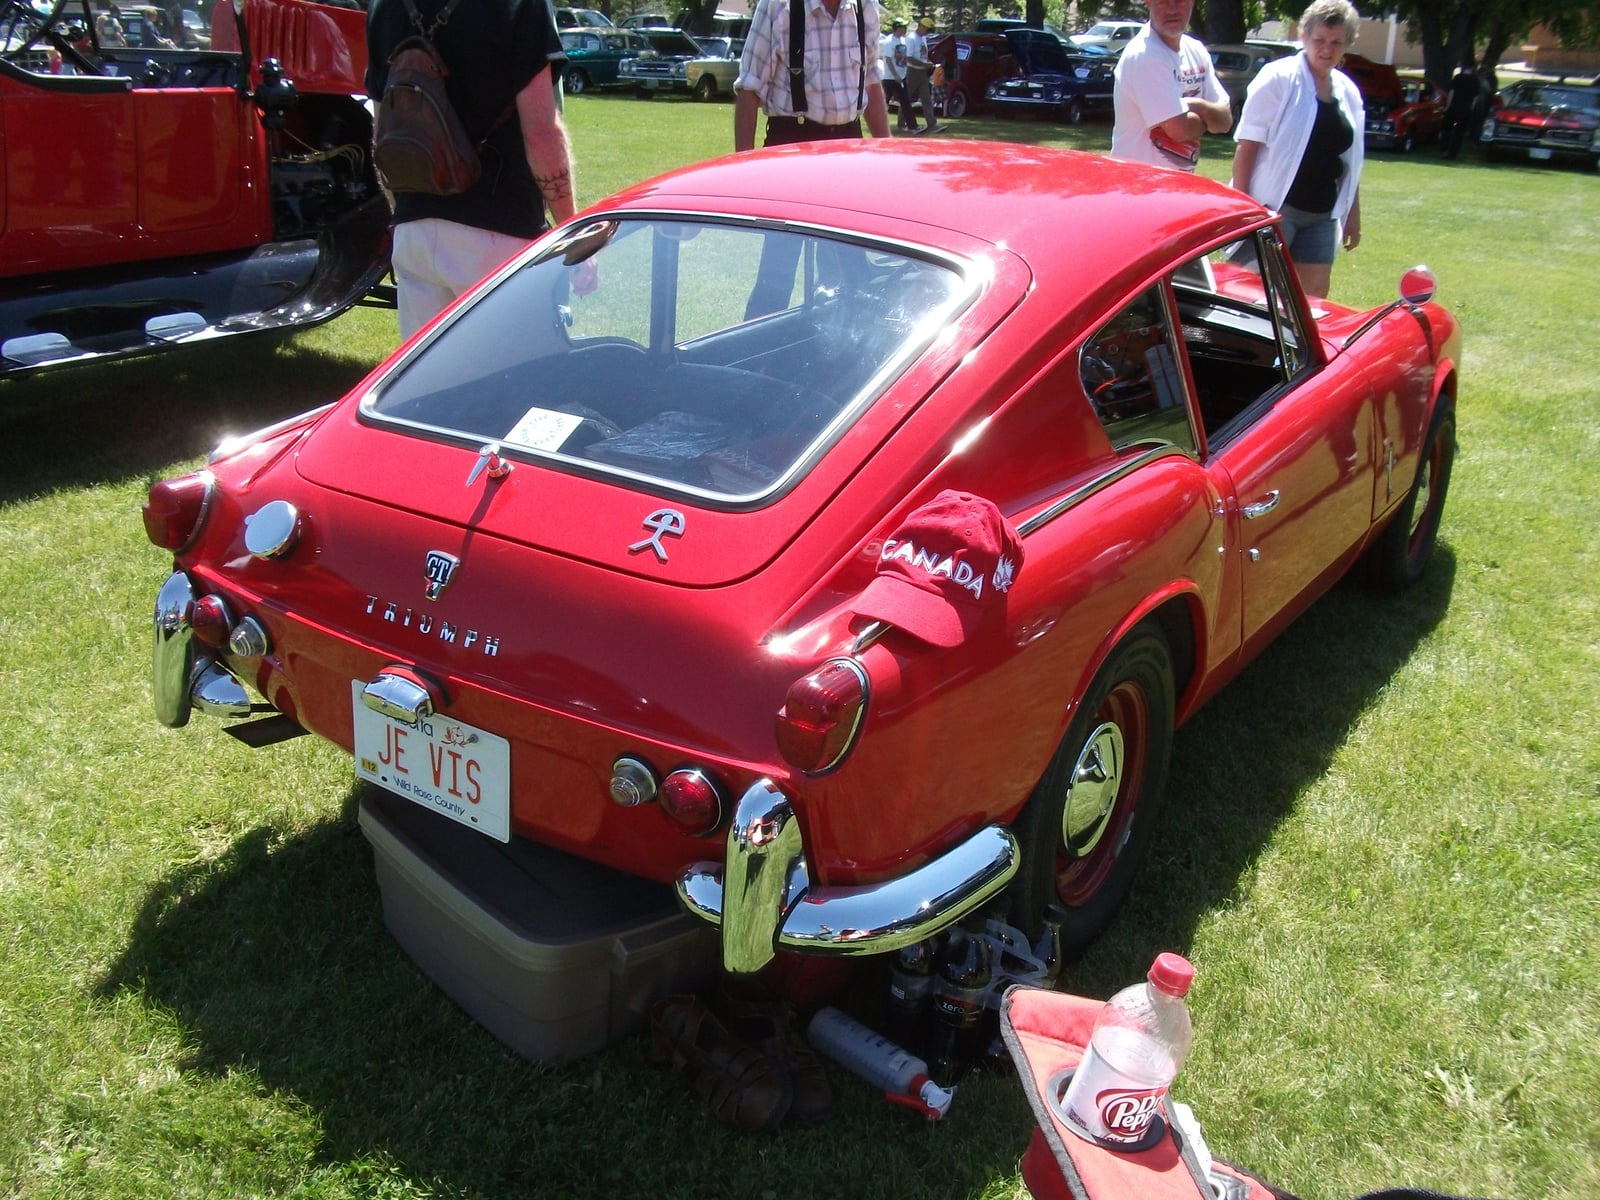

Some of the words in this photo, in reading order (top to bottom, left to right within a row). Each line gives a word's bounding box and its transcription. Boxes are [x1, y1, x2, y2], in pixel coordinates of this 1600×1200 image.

[427, 556, 450, 582] GT
[881, 539, 985, 600] CANADA
[366, 594, 500, 657] TRIUMPH
[378, 723, 409, 774] JE
[429, 742, 481, 804] VIS
[393, 775, 411, 792] Wild
[413, 785, 433, 801] Rose
[434, 795, 466, 816] Country
[942, 1001, 965, 1014] zero
